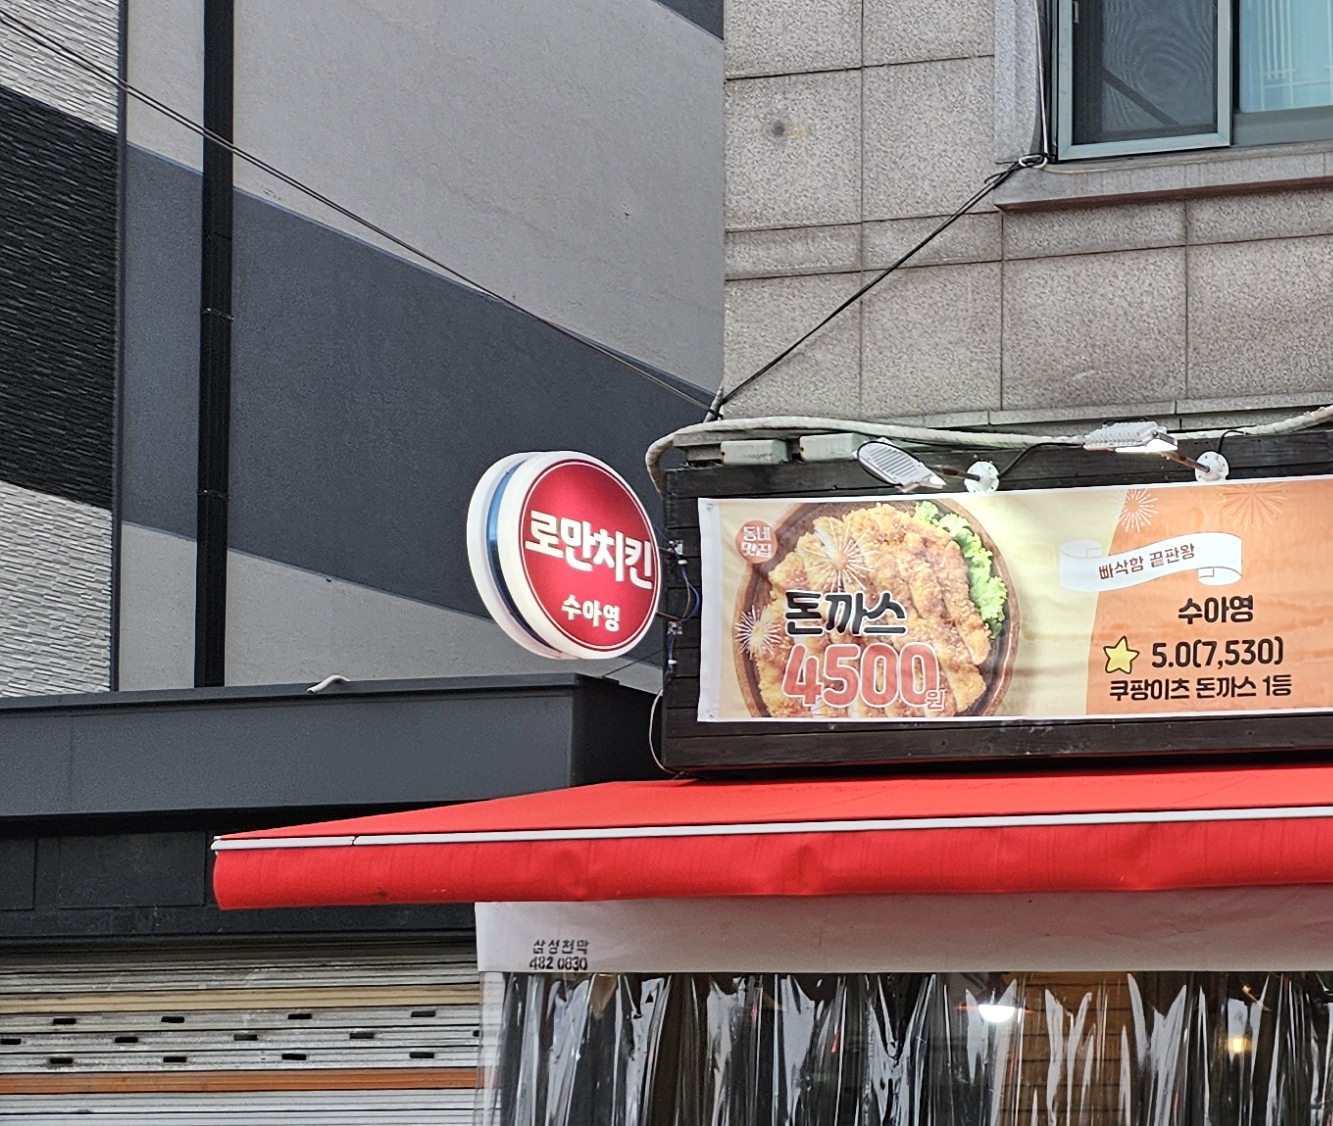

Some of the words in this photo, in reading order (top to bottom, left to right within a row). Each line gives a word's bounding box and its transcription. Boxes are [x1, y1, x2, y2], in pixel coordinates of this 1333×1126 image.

[743, 526, 771, 541] 동네
[525, 507, 654, 592] 로만치킨
[741, 542, 773, 558] 맛집
[1099, 555, 1144, 580] 빠삭함
[1149, 543, 1195, 568] 끝판왕
[560, 594, 622, 632] 수아영
[785, 590, 908, 636] 돈까스
[1178, 595, 1254, 625] 수아영
[1151, 636, 1284, 669] 5.0(7,530)
[782, 641, 945, 711] 4500원
[1109, 677, 1190, 702] 쿠팡이츠
[1196, 675, 1258, 699] 돈까스
[1262, 674, 1292, 697] 1등
[532, 939, 590, 955] 삼성천막
[529, 955, 554, 970] 482
[557, 955, 588, 971] 0830
